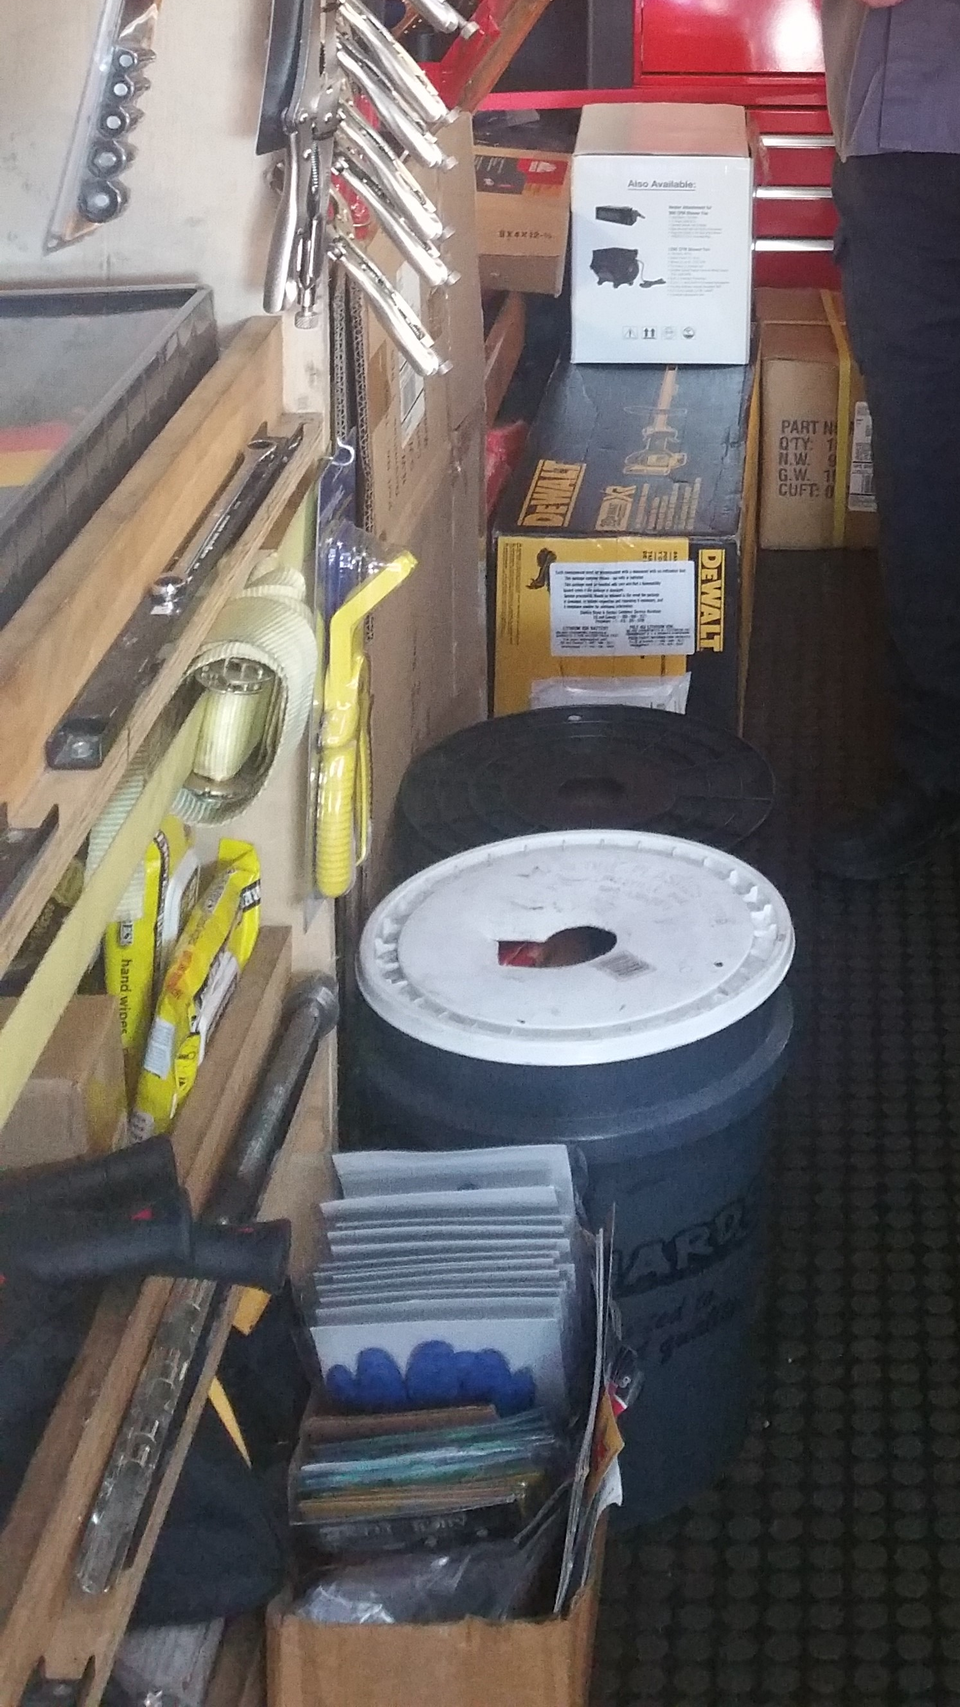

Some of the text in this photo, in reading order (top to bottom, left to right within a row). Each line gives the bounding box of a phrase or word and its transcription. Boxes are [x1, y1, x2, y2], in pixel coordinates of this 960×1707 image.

[628, 179, 697, 188] Also Available:
[781, 420, 819, 434] PART
[780, 437, 814, 451] QTY:
[779, 452, 811, 466] N.W.
[779, 468, 811, 482] G.W.
[522, 459, 583, 527] DEWALT
[779, 483, 820, 498] CUFT:
[698, 549, 725, 652] DEWALT
[120, 958, 133, 992] hand
